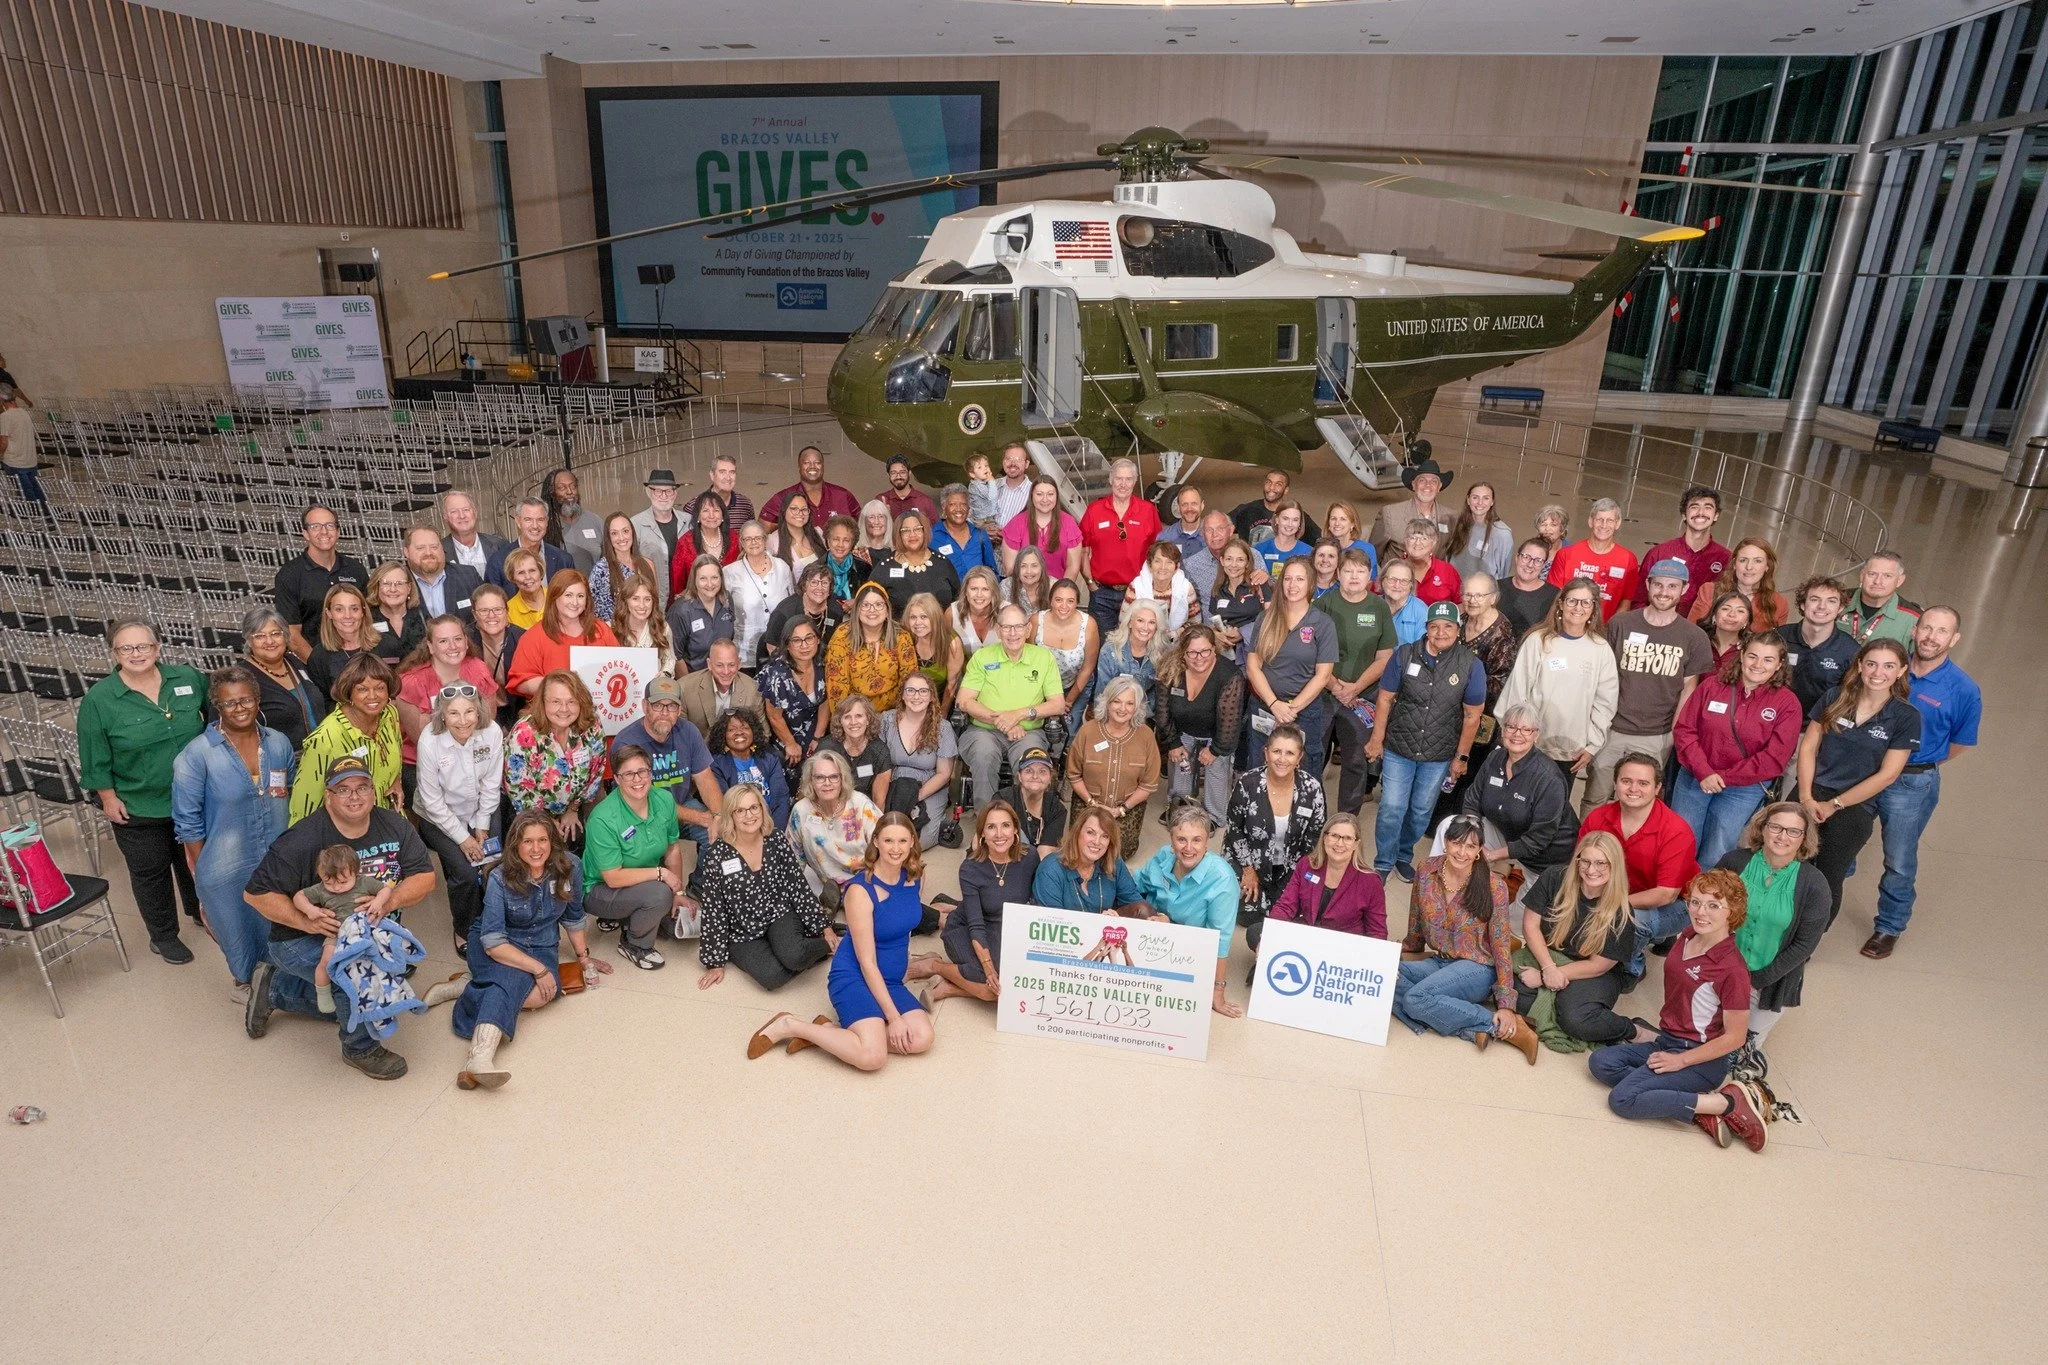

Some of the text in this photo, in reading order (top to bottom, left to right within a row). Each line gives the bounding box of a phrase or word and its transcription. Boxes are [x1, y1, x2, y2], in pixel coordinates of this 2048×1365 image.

[768, 116, 807, 127] Annual
[721, 132, 840, 145] BRAZOS VALLEY
[725, 232, 844, 243] OCTOBER 21 2025
[715, 249, 855, 263] A Day of Giving Championed by
[701, 266, 870, 280] Community Foundation of the Brazos Valley
[1387, 315, 1545, 337] UNITED STATES OF AMERICA
[1573, 568, 1594, 579] Ramp
[1580, 561, 1600, 573] Texas
[1623, 639, 1684, 658] BELOVED
[595, 659, 640, 686] BROOKSHIRE
[606, 673, 628, 708] B
[597, 702, 638, 722] BROTHERS
[1105, 932, 1125, 940] FIRST
[1137, 934, 1170, 951] give
[1062, 958, 1151, 976] BrazosValleyGives.org
[1316, 960, 1384, 985] Amarillo
[1049, 967, 1163, 992] Thanks for supporting
[1314, 973, 1381, 998] National
[1013, 975, 1197, 1013] 2025 BRAZOS VALLEY GIVES!
[1312, 986, 1354, 1006] Bank
[1019, 995, 1151, 1029] $ 1,561,033
[1037, 1024, 1166, 1050] to 200 participating nonprofits
